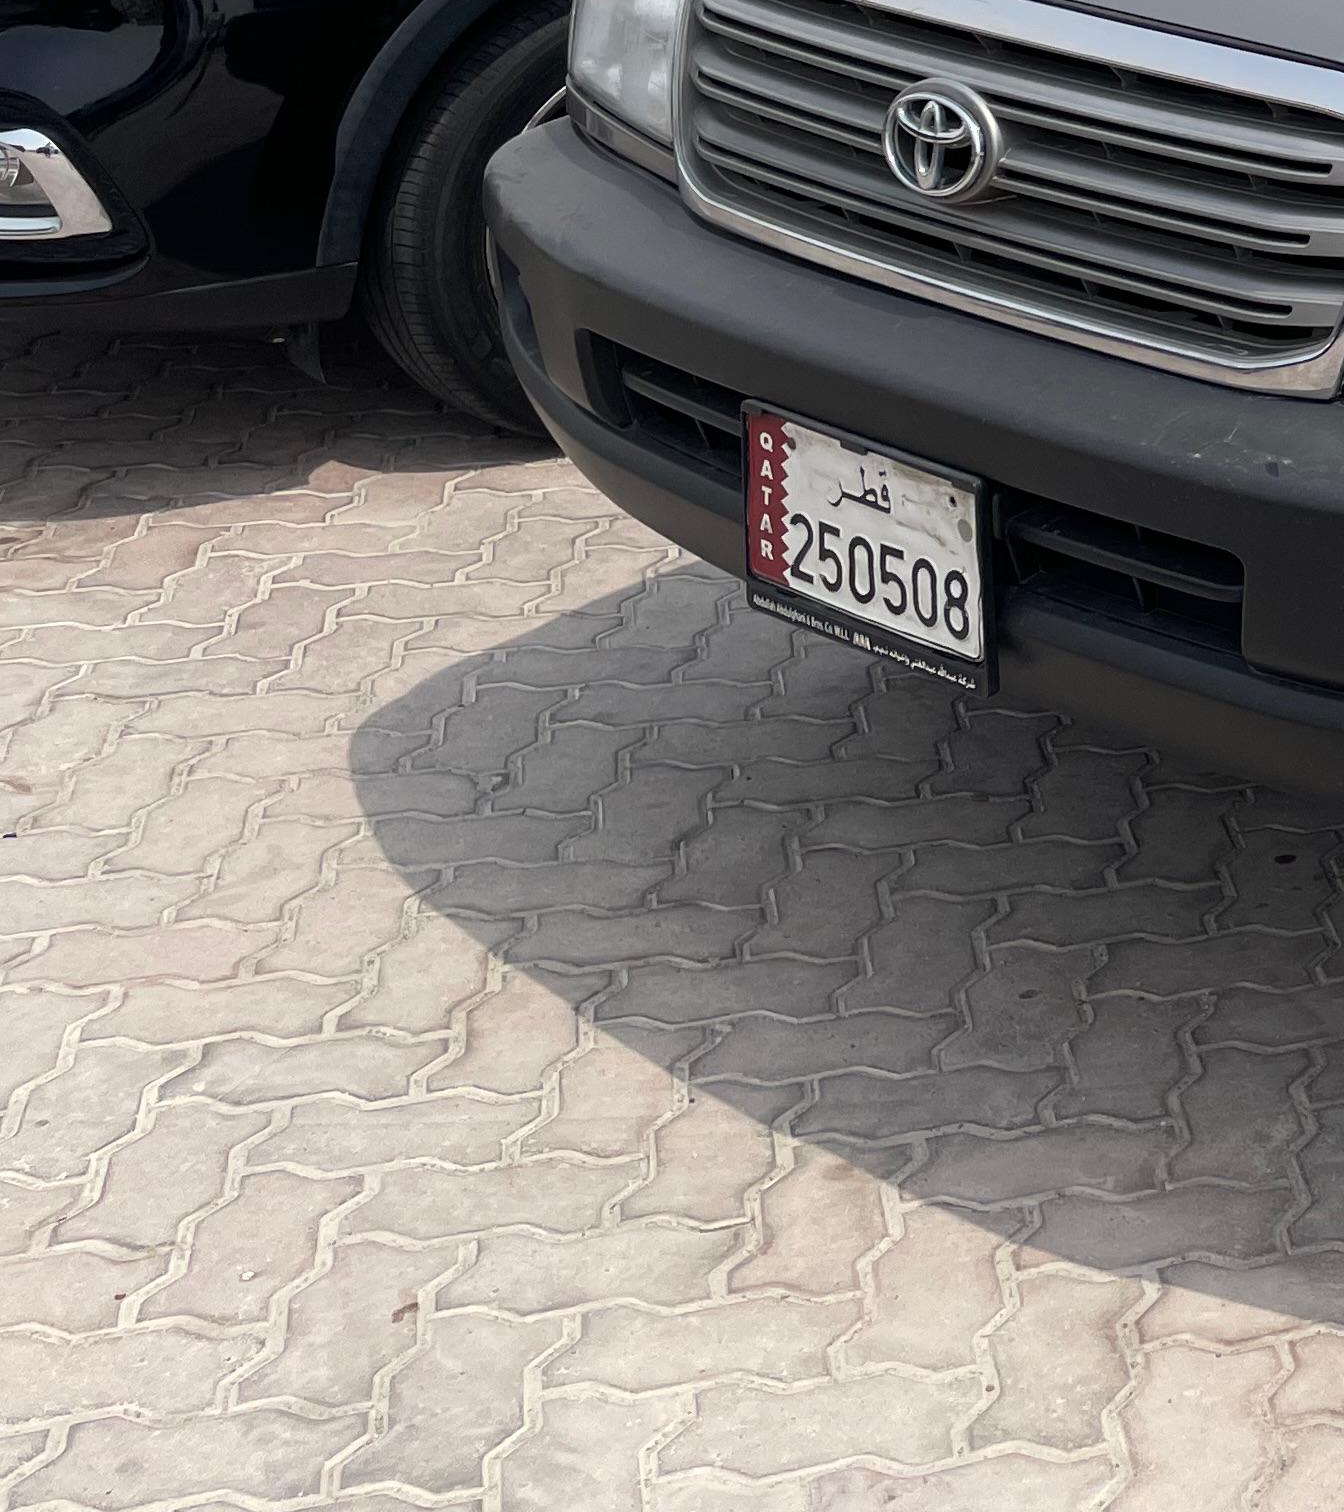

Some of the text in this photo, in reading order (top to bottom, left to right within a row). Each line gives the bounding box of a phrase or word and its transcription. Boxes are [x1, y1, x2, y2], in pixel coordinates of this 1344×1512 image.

[759, 431, 775, 561] QATAR
[827, 466, 891, 514] قطر
[789, 513, 971, 640] 250508
